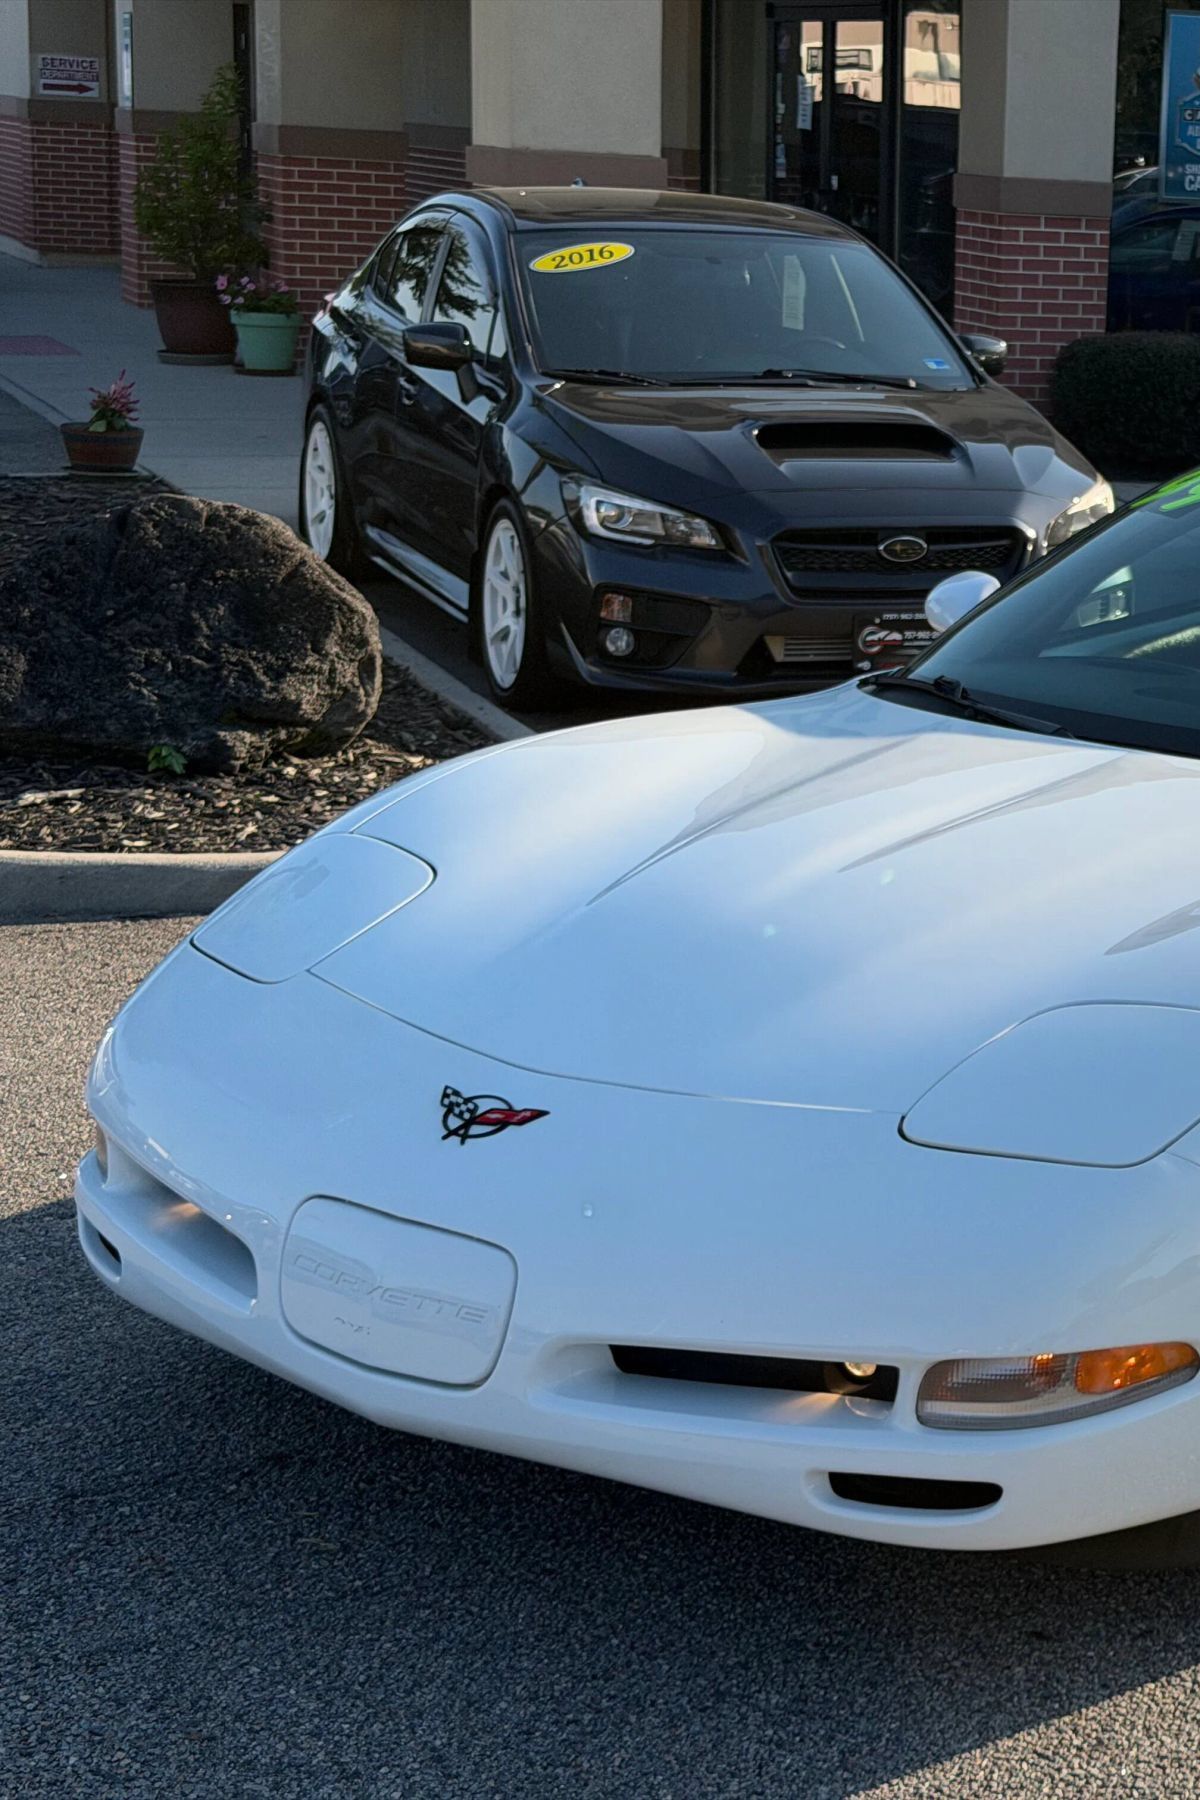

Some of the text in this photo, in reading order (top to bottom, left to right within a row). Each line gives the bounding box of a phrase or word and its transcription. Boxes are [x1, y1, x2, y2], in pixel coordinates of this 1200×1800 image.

[41, 57, 98, 70] SERVICE
[551, 245, 615, 269] 2016
[293, 1253, 490, 1326] CORVETTE
